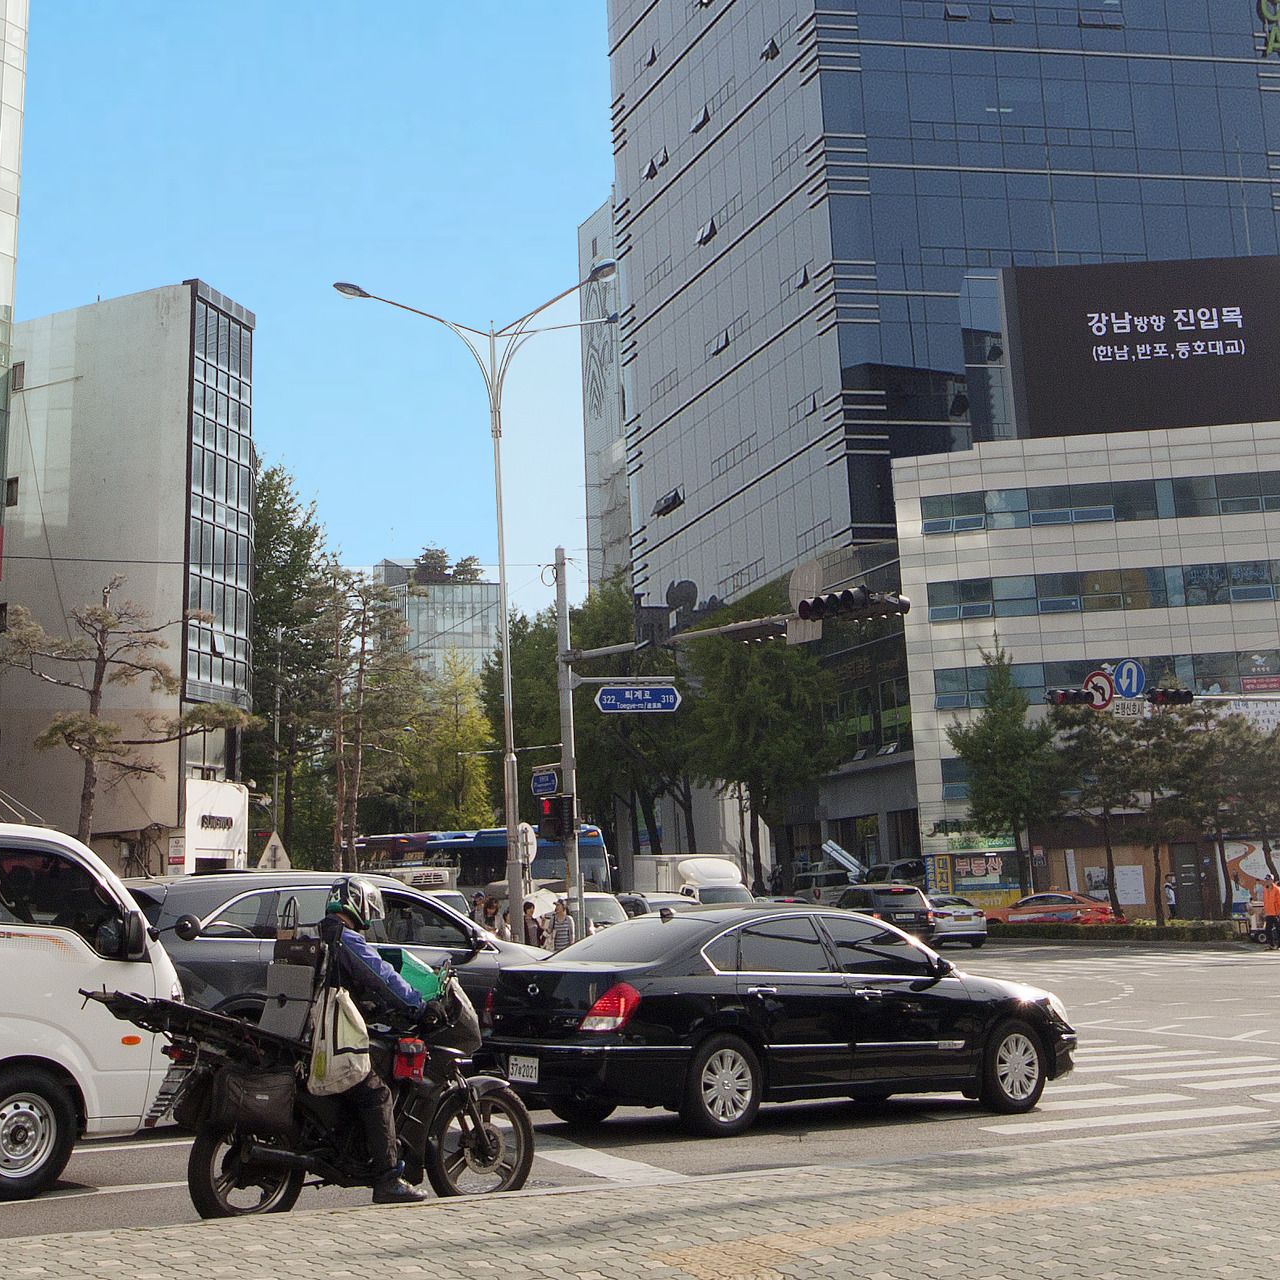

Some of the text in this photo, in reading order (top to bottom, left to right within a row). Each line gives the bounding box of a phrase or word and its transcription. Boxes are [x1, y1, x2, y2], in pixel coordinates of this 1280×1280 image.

[1087, 306, 1244, 336] 강남방향 진입목
[1092, 339, 1246, 363] (한남,반포,동호대교)
[602, 690, 675, 704] 322 퇴계로 318
[954, 856, 1003, 877] 부동산
